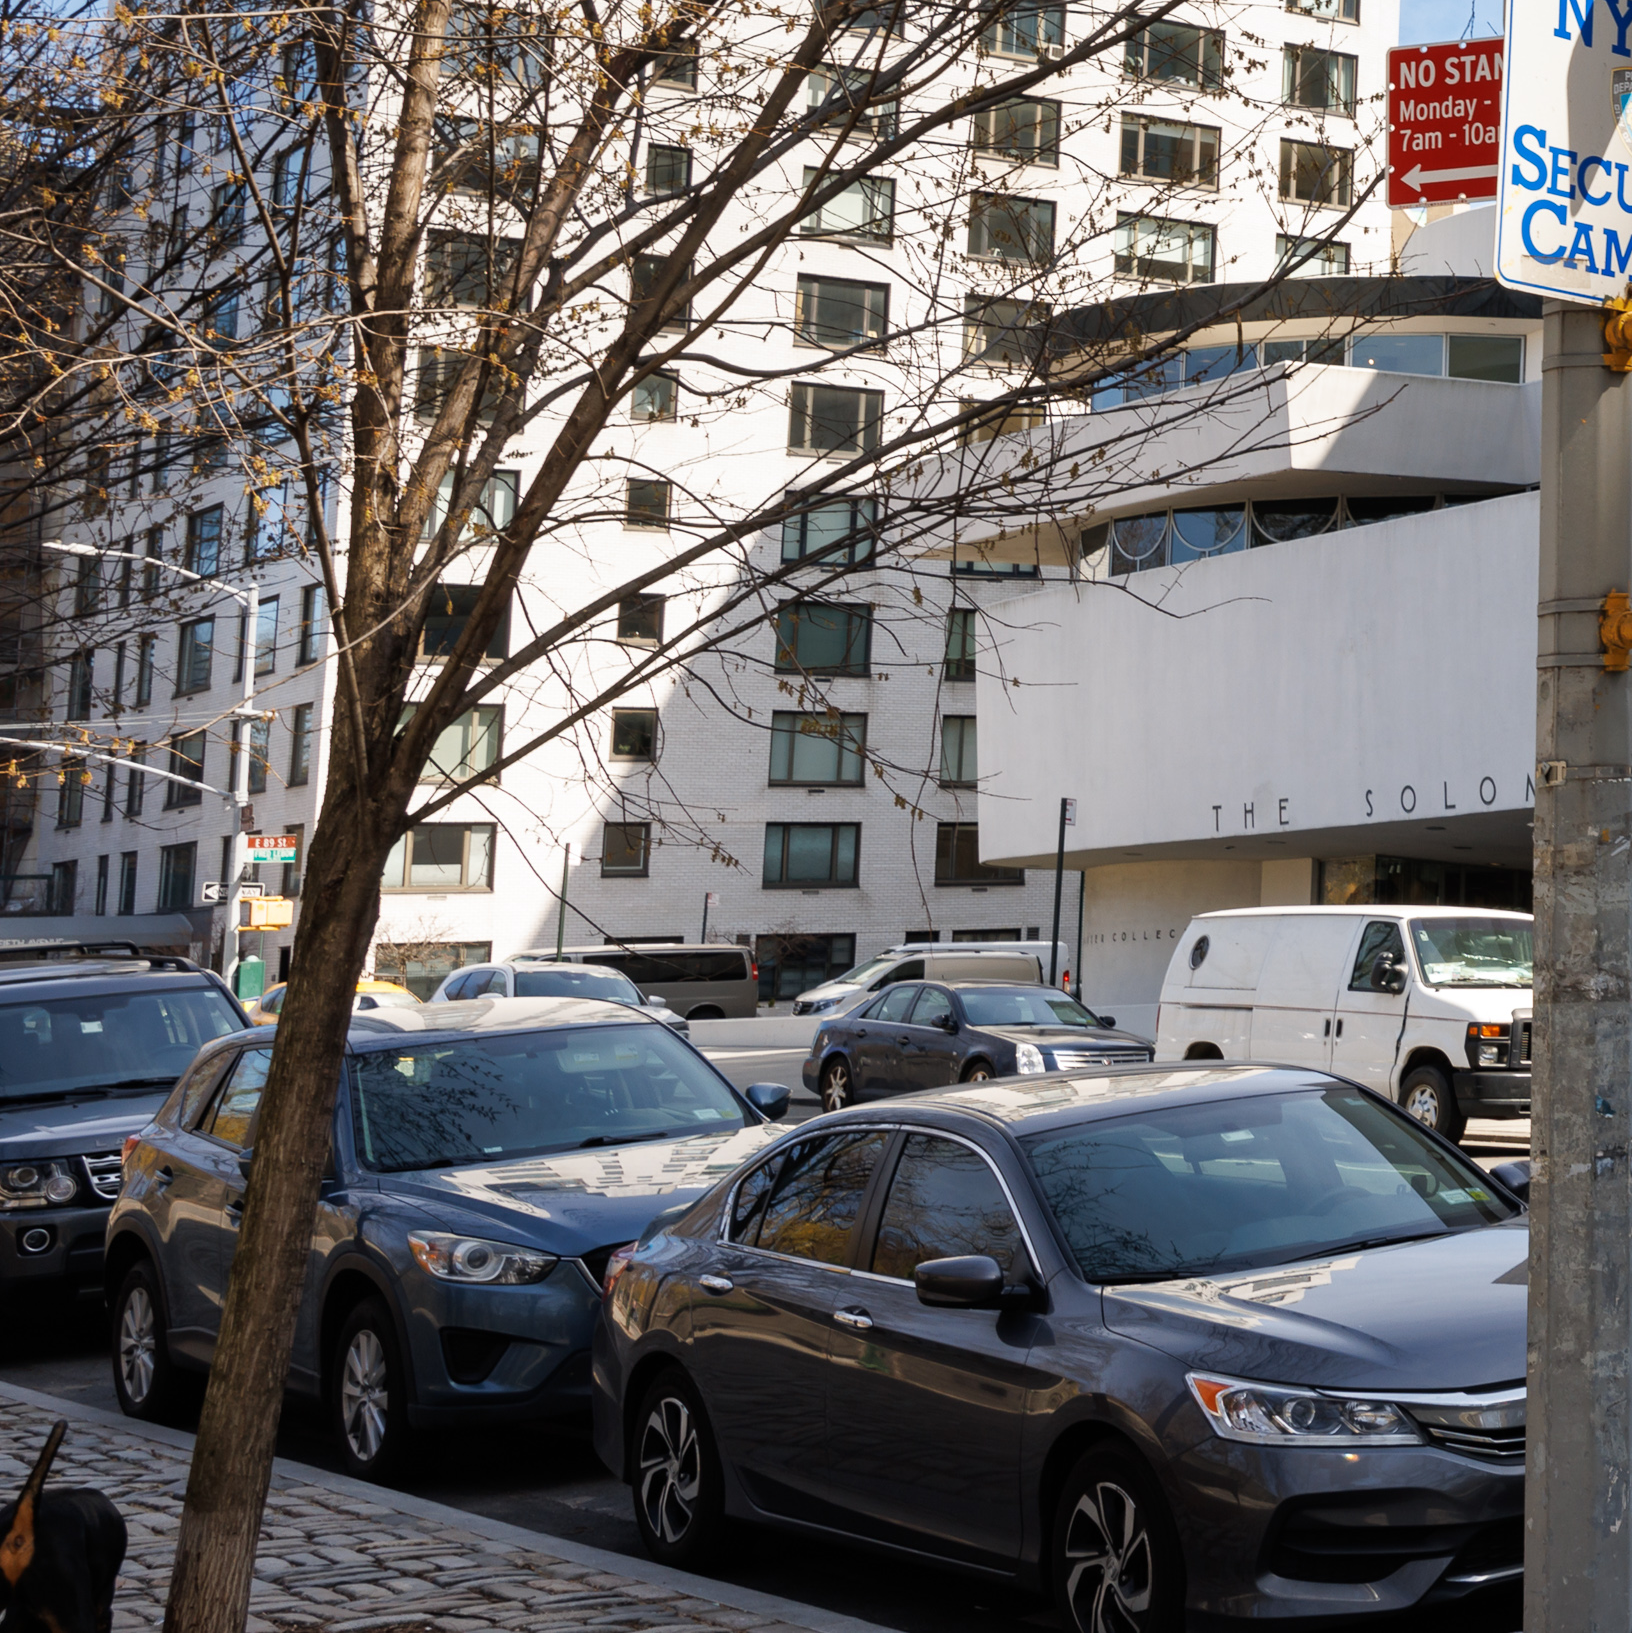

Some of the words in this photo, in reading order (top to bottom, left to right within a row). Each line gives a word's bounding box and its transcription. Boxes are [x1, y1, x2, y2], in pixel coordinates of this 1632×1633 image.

[1399, 59, 1436, 89] NO
[1443, 54, 1504, 83] STAN
[1399, 97, 1479, 123] Monday
[1399, 129, 1441, 152] 7am
[1463, 124, 1500, 147] 10a
[1212, 798, 1291, 832] THE
[255, 838, 260, 847] E
[263, 838, 274, 847] 89
[277, 838, 287, 847] St
[1112, 929, 1175, 941] COLLEC
